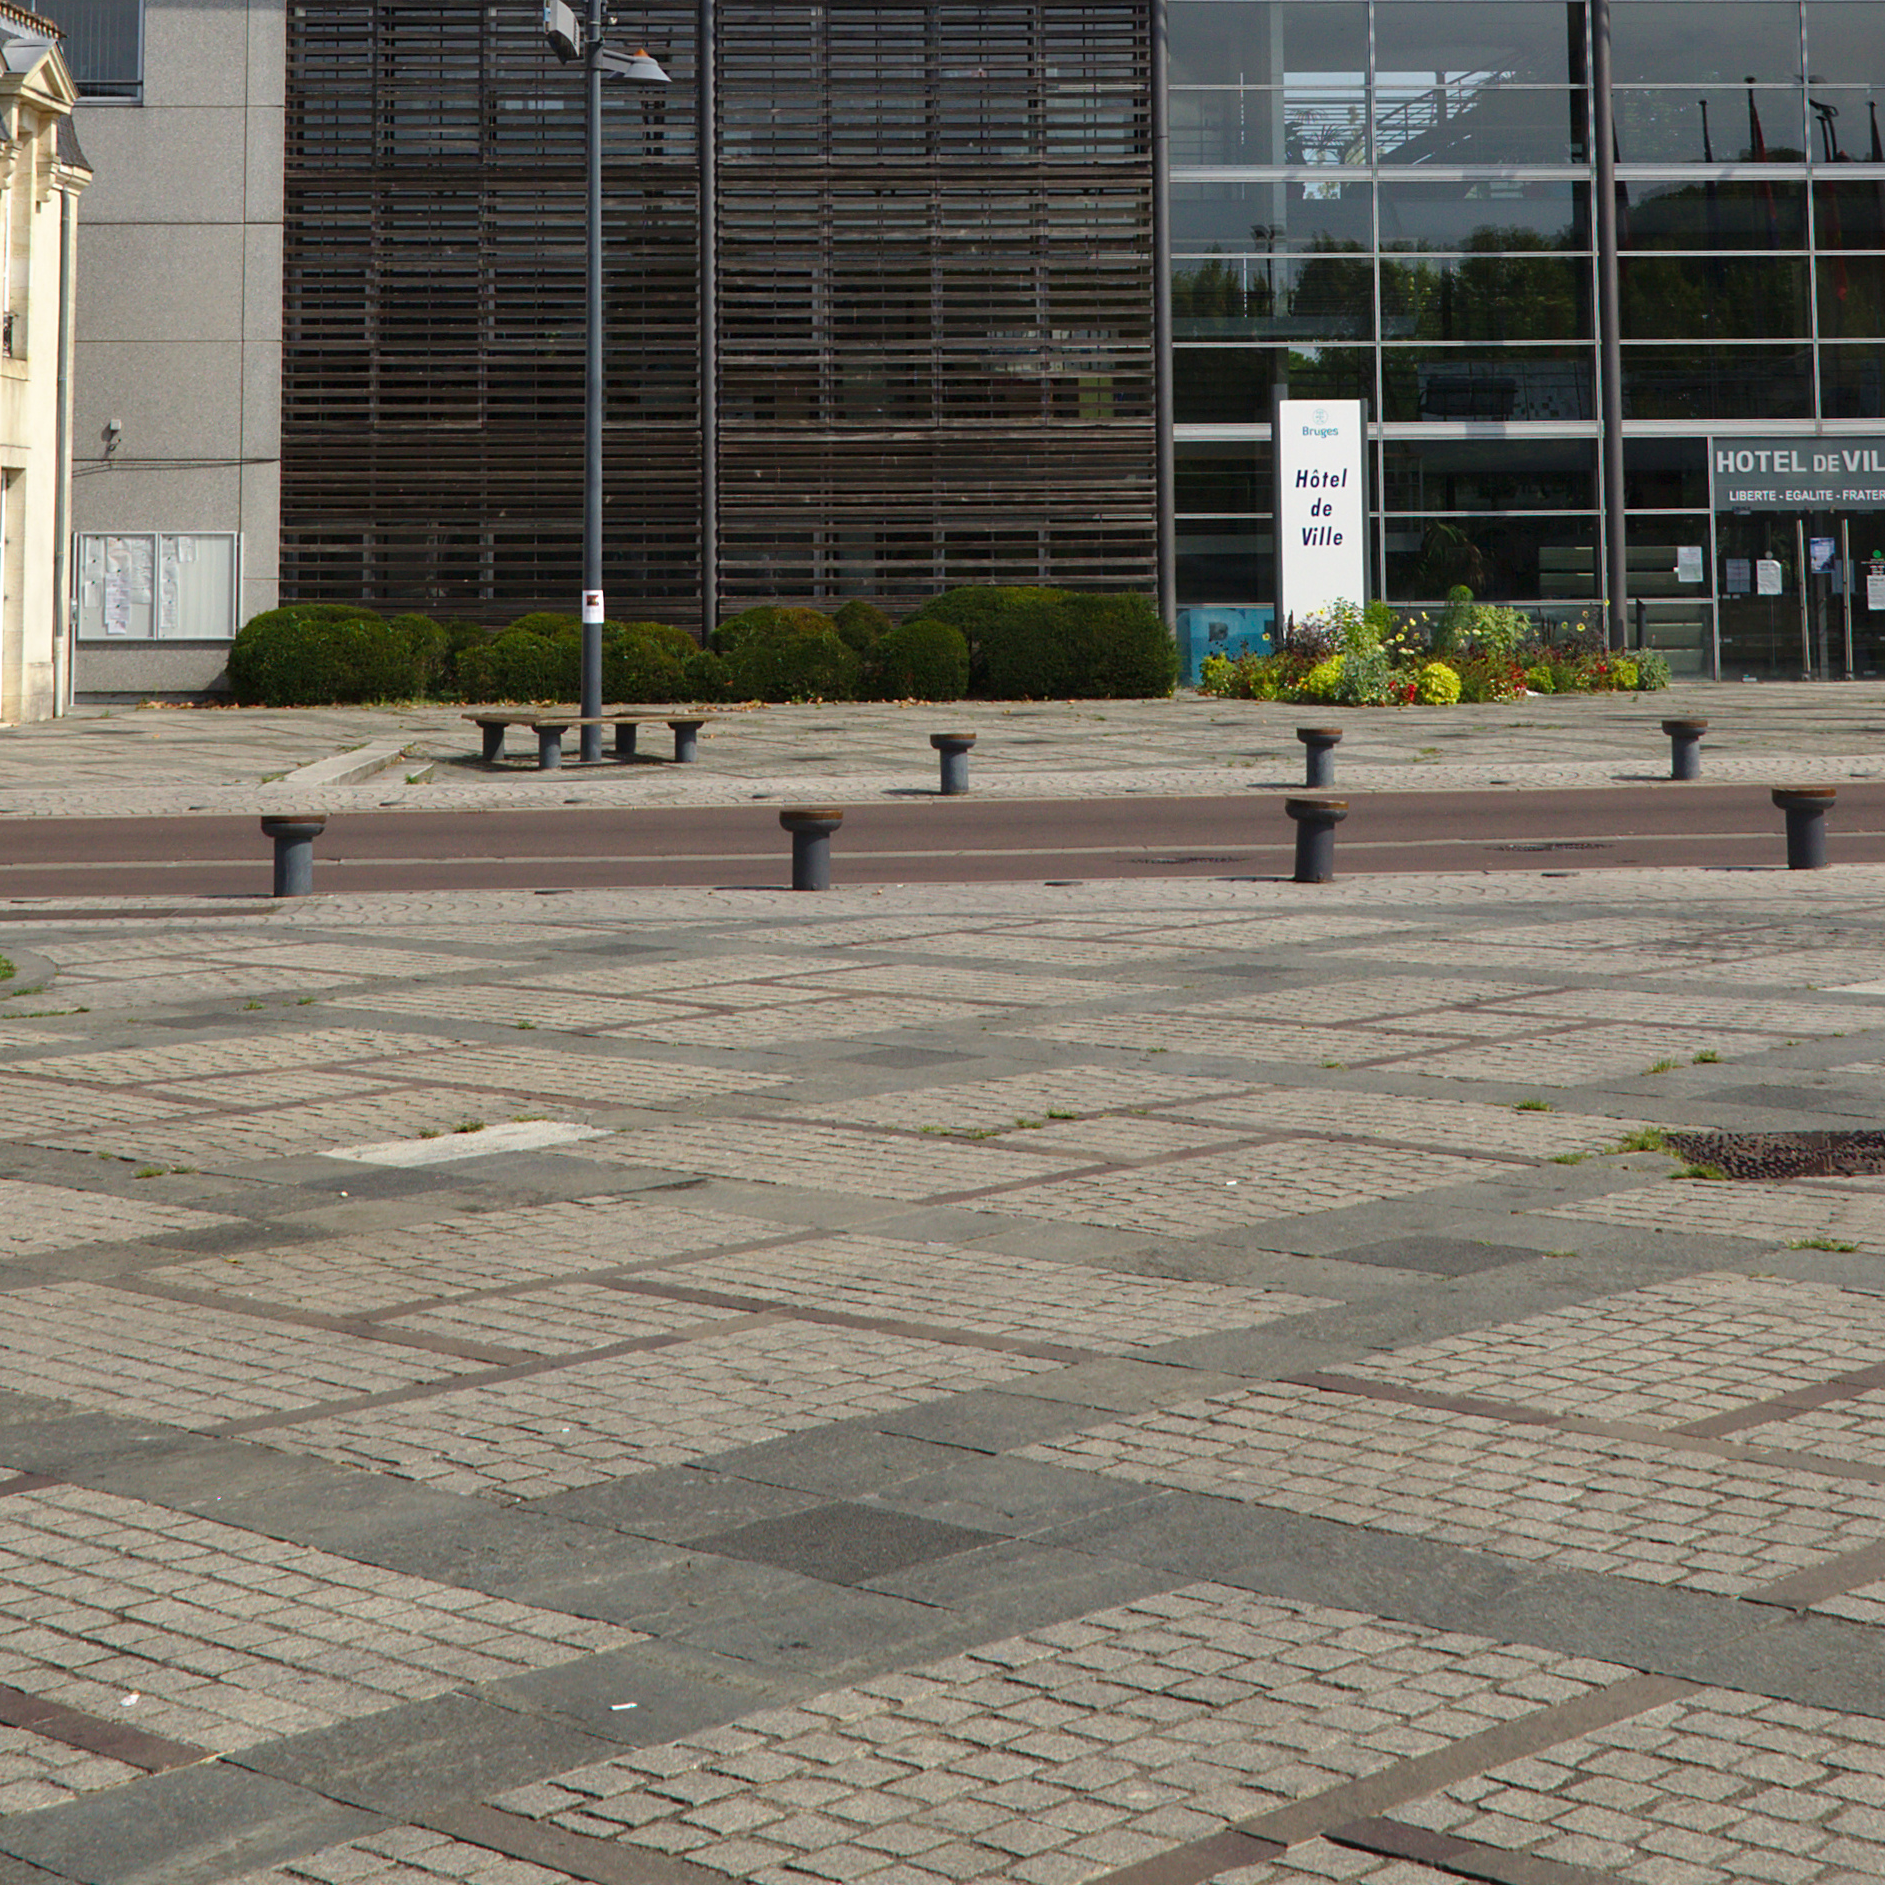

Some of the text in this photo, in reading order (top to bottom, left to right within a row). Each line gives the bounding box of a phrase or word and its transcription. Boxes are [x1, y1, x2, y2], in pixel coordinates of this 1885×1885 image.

[1302, 426, 1339, 438] Bruges
[1716, 450, 1807, 473] HOTEL
[1813, 454, 1840, 472] DE
[1295, 468, 1347, 488] Hôtel
[1729, 490, 1776, 501] LIBERTE
[1785, 490, 1833, 501] EGALITE
[1311, 497, 1333, 517] de
[1301, 526, 1343, 546] Ville
